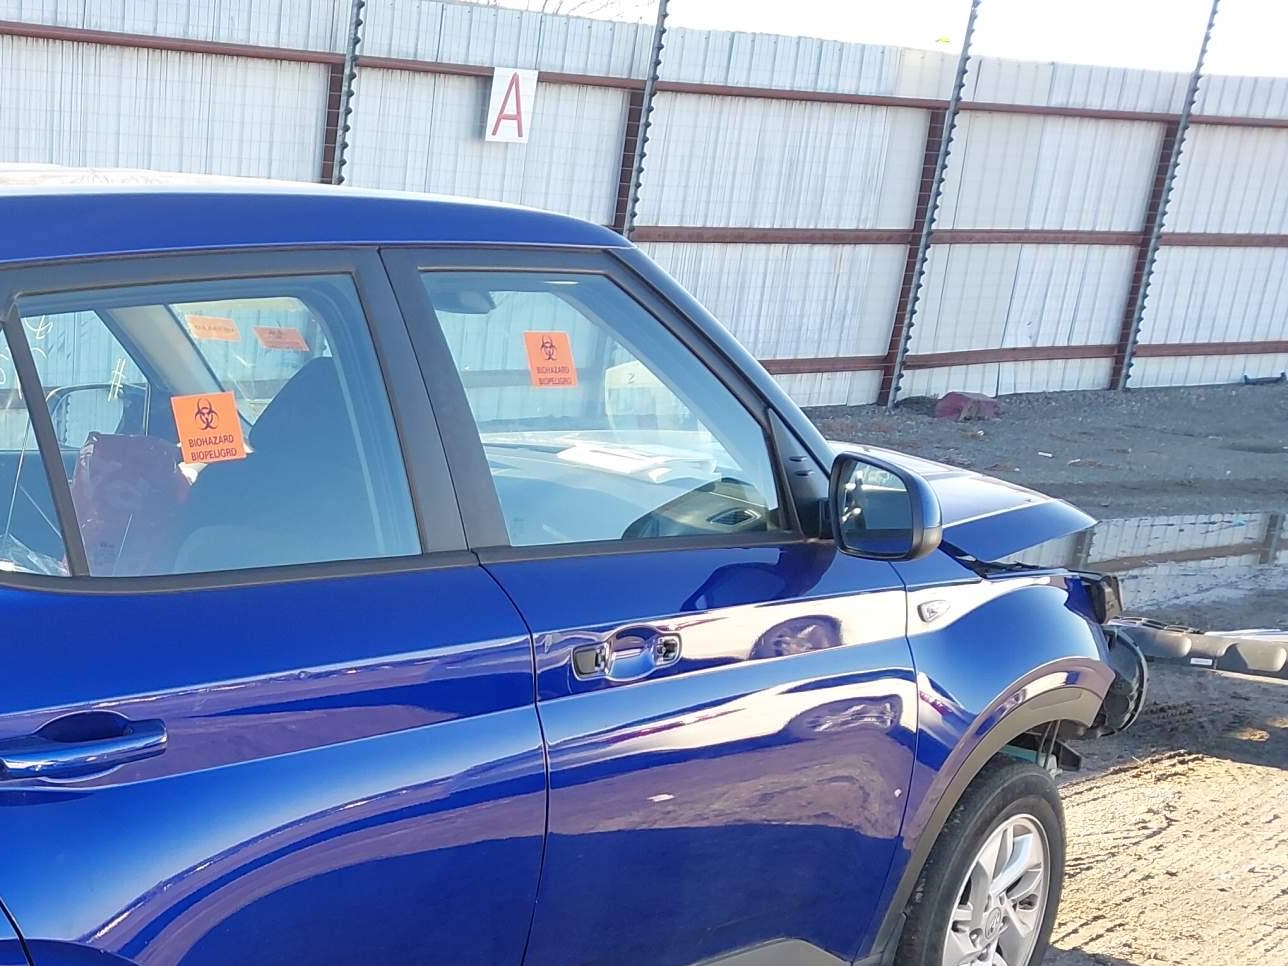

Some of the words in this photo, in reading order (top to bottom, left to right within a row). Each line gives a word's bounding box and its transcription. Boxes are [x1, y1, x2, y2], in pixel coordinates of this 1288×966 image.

[491, 72, 523, 138] A
[536, 366, 570, 374] BIOHAZARD
[188, 434, 234, 448] BIOHAZARD
[191, 448, 237, 461] BIOPELIGRO
